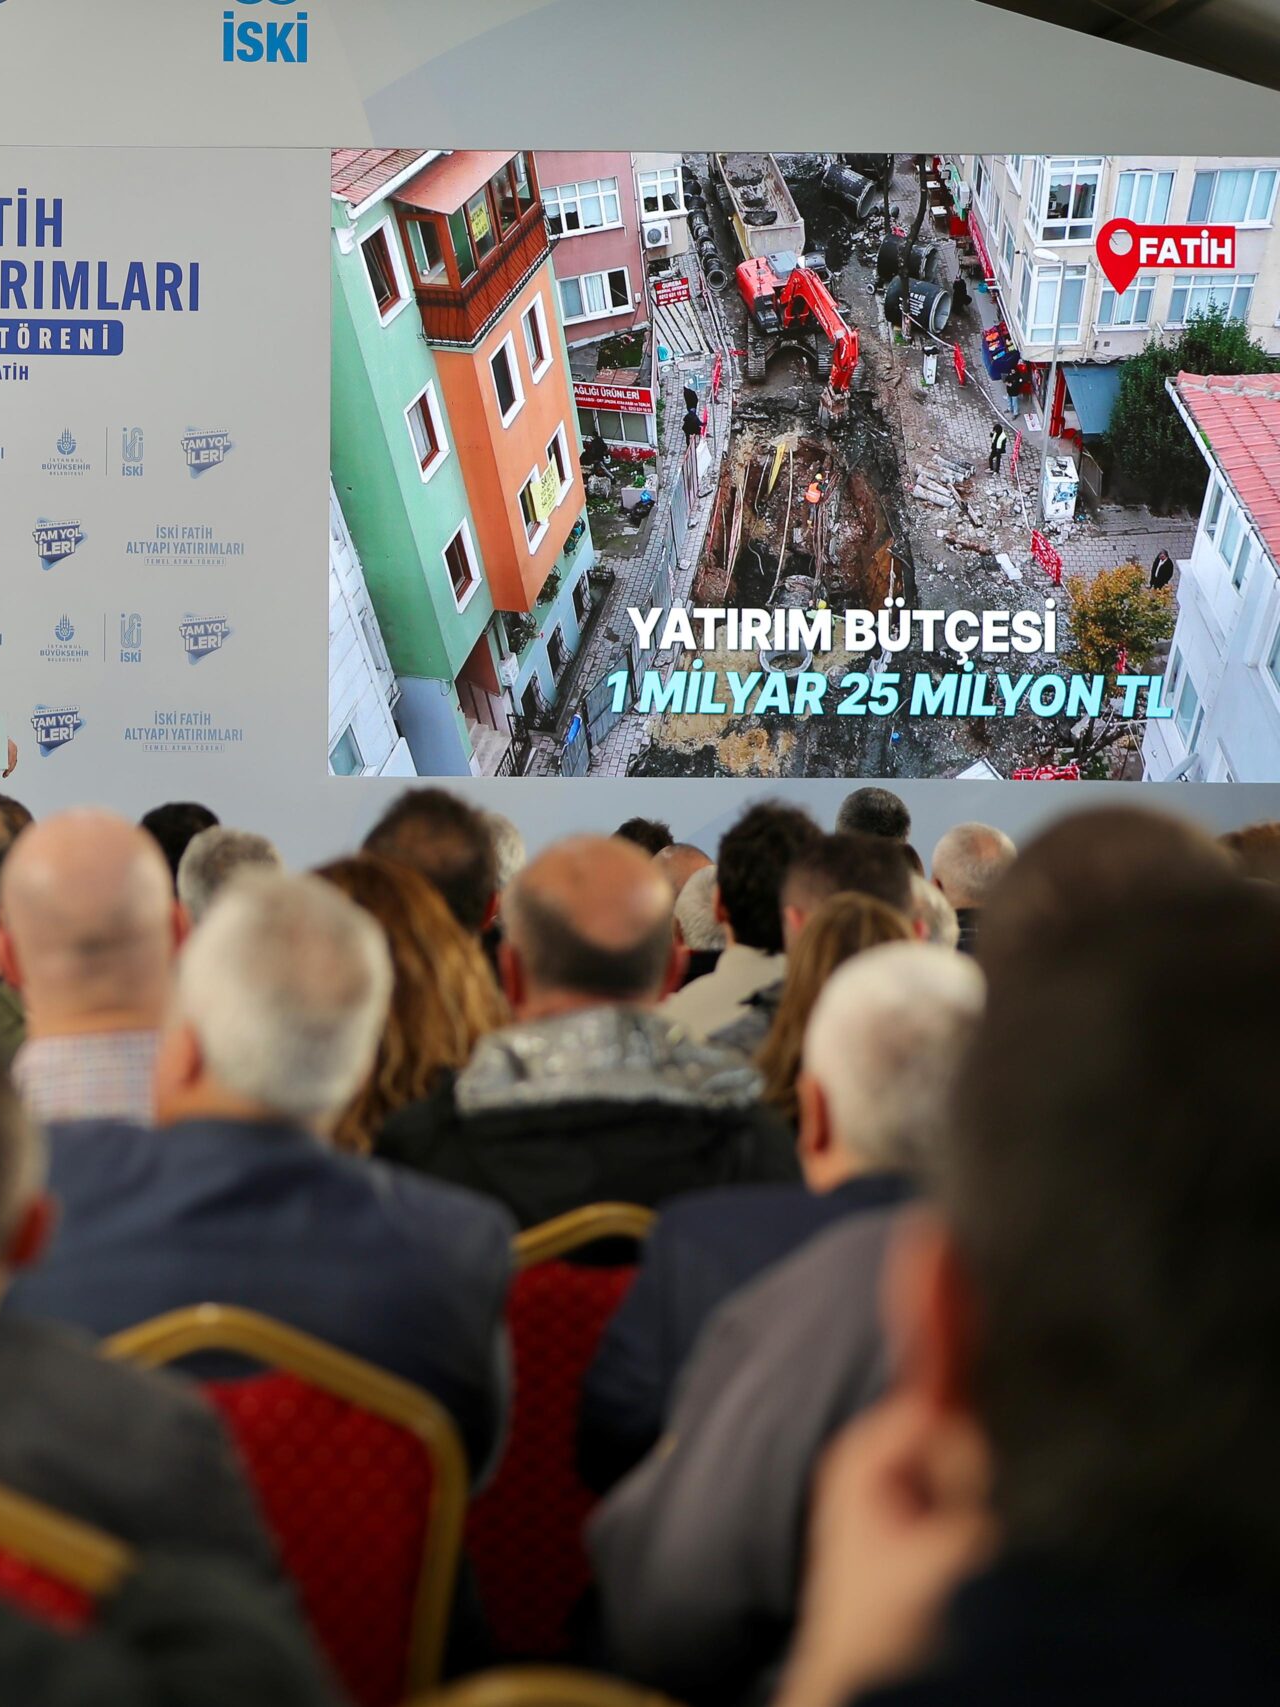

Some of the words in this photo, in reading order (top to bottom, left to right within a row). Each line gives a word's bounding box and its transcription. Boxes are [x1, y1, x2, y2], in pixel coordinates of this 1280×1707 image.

[223, 11, 308, 62] İSKİ
[1140, 230, 1232, 264] FATİH
[600, 388, 640, 400] ÜRÜNLERİ
[182, 438, 206, 449] TAM
[208, 436, 231, 448] YOL
[188, 446, 223, 464] İLERİ
[122, 463, 143, 476] İSKİ
[33, 530, 58, 541] TAM
[59, 528, 82, 539] YOL
[156, 524, 179, 539] İSKİ
[181, 524, 213, 539] FATİH
[39, 537, 75, 556] İLERİ
[126, 541, 170, 554] ALTYAPI
[173, 542, 244, 555] YATIRIMLARI
[179, 625, 204, 636] TAM
[206, 622, 229, 633] YOL
[627, 607, 831, 651] YATIRIM
[845, 597, 1056, 665] BÜTÇESİ
[185, 632, 222, 650] İLERİ
[40, 648, 89, 656] BÜYÜKŞEHİR
[120, 649, 142, 662] İSKİ
[607, 670, 629, 713] 1
[639, 658, 827, 715] MİLYAR
[837, 673, 900, 716] 25
[910, 661, 1105, 717] MİLYON
[1116, 675, 1173, 718] TL
[31, 716, 56, 727] TAM
[58, 714, 80, 725] YOL
[154, 710, 177, 725] İSKİ
[180, 711, 211, 725] FATİH
[37, 724, 74, 743] İLERİ
[124, 728, 168, 740] ALTYAPI
[171, 728, 243, 741] YATIRIMLARI
